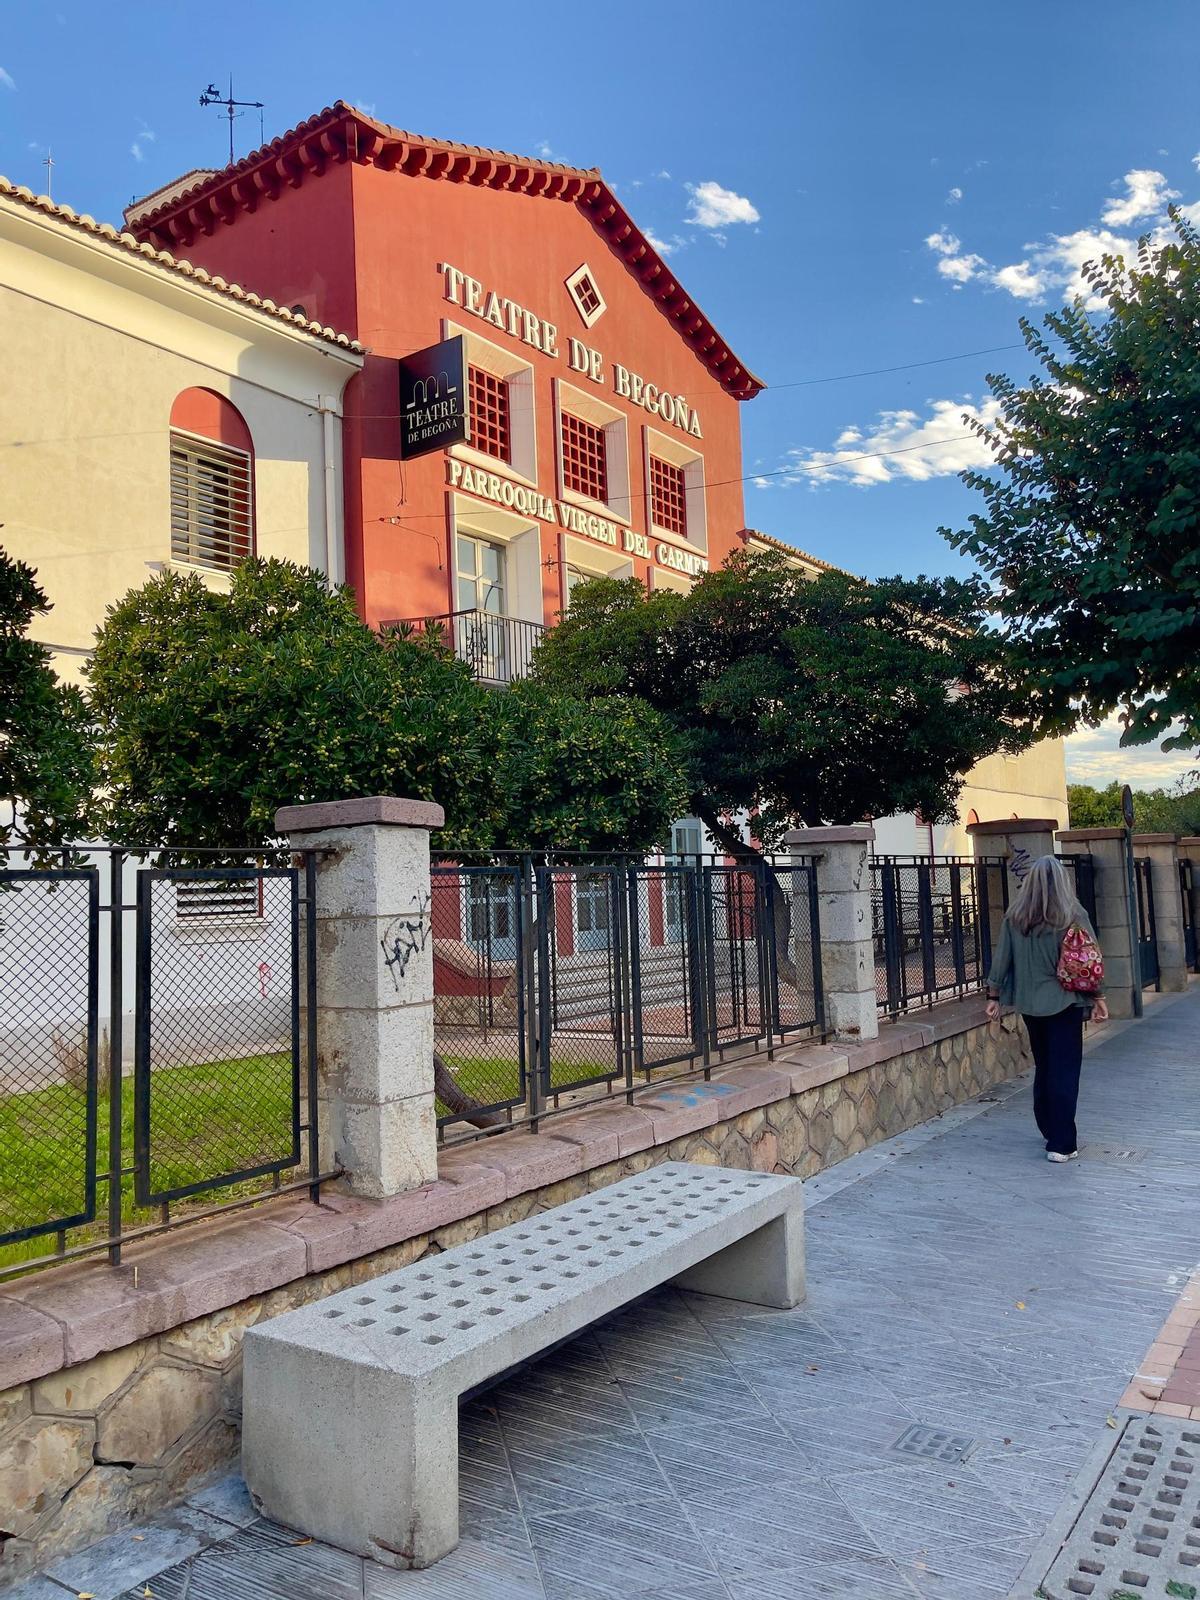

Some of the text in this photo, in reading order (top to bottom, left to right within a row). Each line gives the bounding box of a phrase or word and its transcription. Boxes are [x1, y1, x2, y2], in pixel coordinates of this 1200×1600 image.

[441, 262, 704, 440] TEATRE DE BEGOÑA
[406, 397, 458, 430] TEATRE
[408, 418, 458, 444] DE BEGOÑA
[449, 459, 709, 579] PARROQUIA VIRGEN DEL CARMEN
